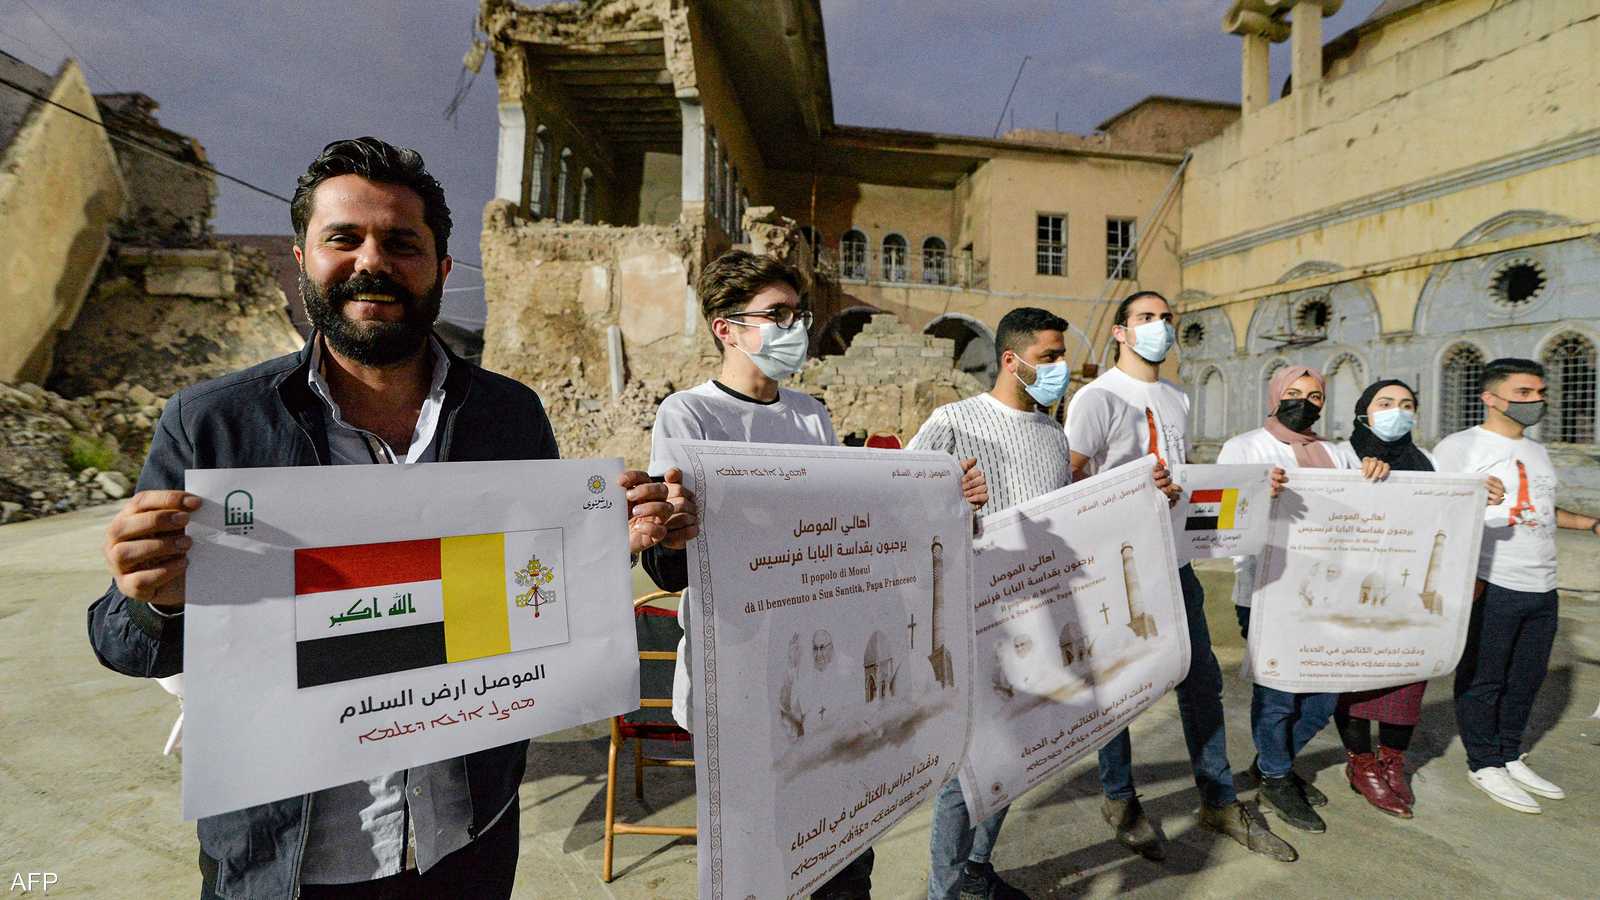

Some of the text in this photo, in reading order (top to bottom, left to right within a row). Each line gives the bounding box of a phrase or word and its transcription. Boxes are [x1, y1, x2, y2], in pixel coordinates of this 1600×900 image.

[793, 512, 870, 538] أهالي الموصل
[749, 538, 907, 571] يرحبون بقداسة البابا فرنسيس
[989, 550, 1056, 587] أهالي الموصل
[810, 569, 838, 586] popolo
[839, 567, 847, 579] di
[848, 565, 871, 577] Mosul
[1003, 580, 1025, 597] البابا
[1027, 568, 1061, 586] بقداسة
[744, 602, 756, 614] dà
[757, 600, 765, 612] il
[766, 594, 811, 611] benvenuto
[818, 589, 834, 599] Sua
[866, 580, 884, 593] Papa
[884, 574, 917, 588] Francesco
[339, 663, 546, 724] الموصل ارض السلام
[849, 783, 886, 818] الكنائس
[791, 817, 826, 851] الحدباء
[829, 807, 847, 832] في
